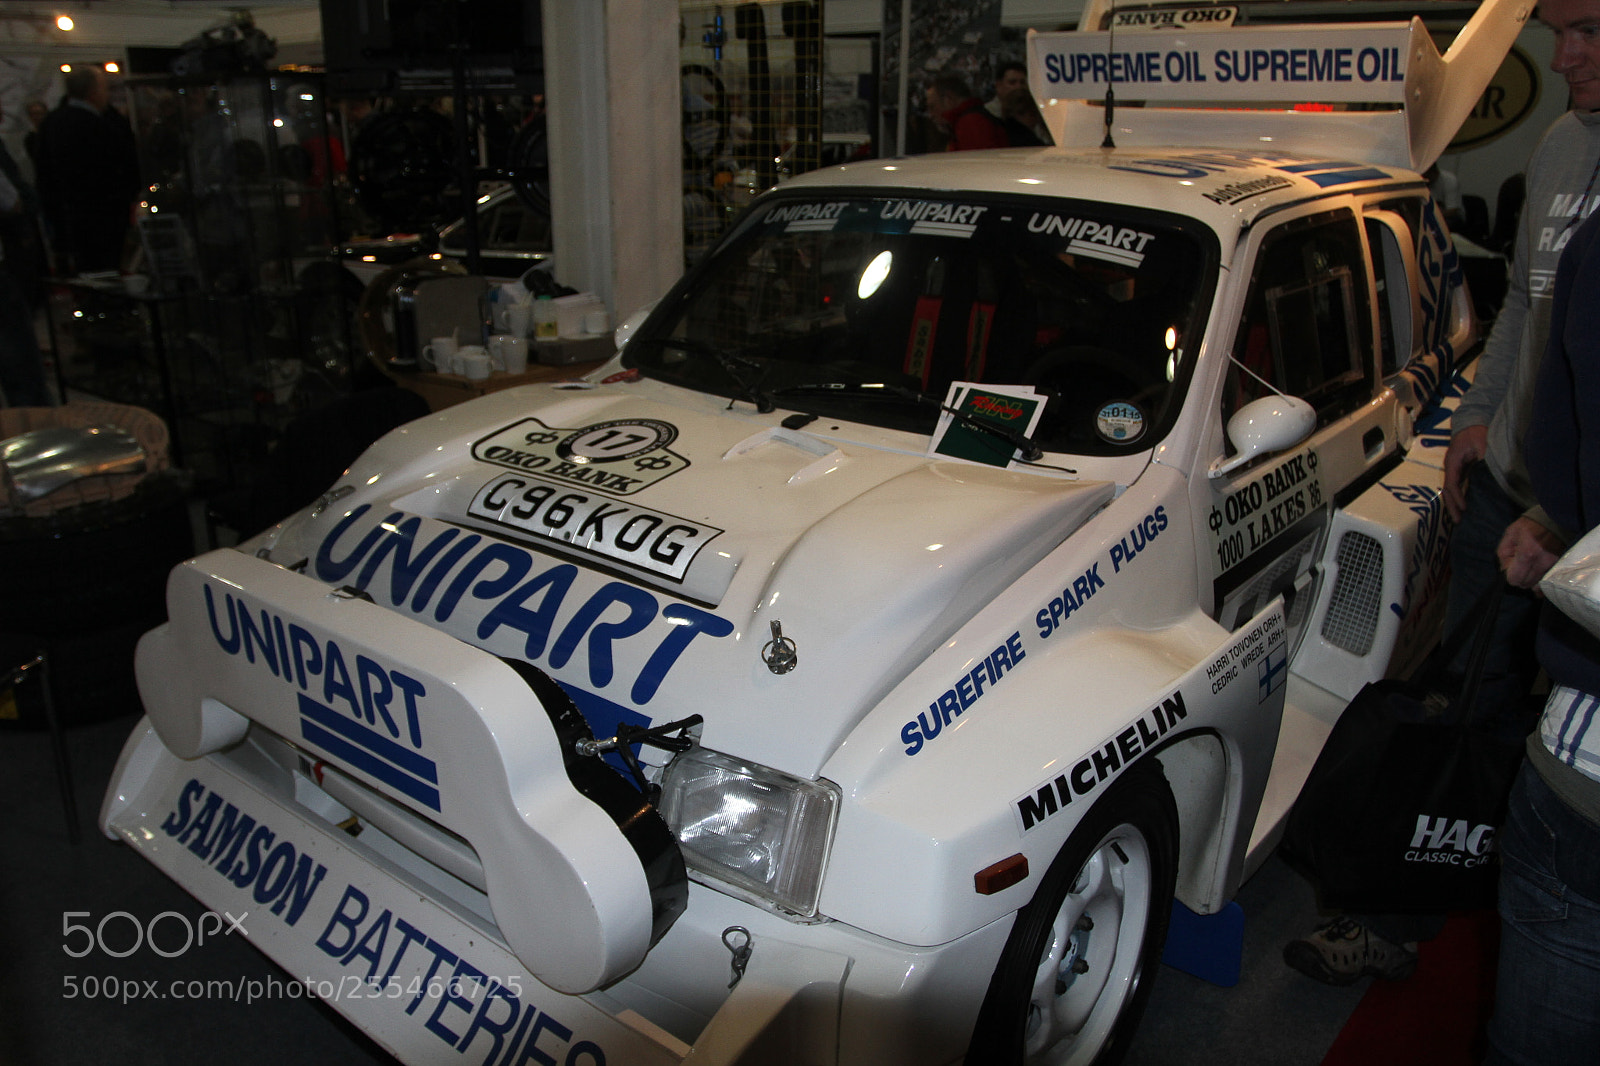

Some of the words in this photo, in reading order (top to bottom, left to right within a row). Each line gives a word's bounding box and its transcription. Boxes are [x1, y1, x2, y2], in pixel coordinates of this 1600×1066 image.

[1116, 10, 1175, 26] BANK
[1182, 8, 1232, 23] OKO
[1045, 51, 1161, 84] SUPREME
[1165, 50, 1206, 83] OIL
[1214, 48, 1352, 83] SUPREME
[1357, 46, 1405, 82] OIL
[764, 201, 850, 223] UNIPART
[880, 201, 988, 226] UNIPART
[1027, 213, 1156, 253] UNIPART
[1112, 407, 1127, 418] 01
[585, 430, 649, 451] 17
[484, 446, 551, 469] OKO
[545, 462, 643, 492] BANK
[1225, 481, 1263, 526] OKO
[1263, 454, 1307, 503] BANK
[1218, 530, 1244, 571] 1000
[1247, 489, 1306, 551] LAKES
[315, 504, 735, 706] UNIPART
[901, 631, 1026, 757] SUREFIRE
[1036, 562, 1105, 639] SPARK
[1109, 505, 1169, 573] PLUGS
[204, 584, 426, 749] UNIPART
[1206, 653, 1230, 680] HARRI
[1228, 625, 1264, 661] TOIVONEN
[1211, 665, 1239, 695] CEDRIC
[1241, 643, 1265, 670] WREDE
[1017, 691, 1188, 831] MICHELIN
[160, 778, 328, 927] SAMSON
[1403, 850, 1462, 865] CLASSIC
